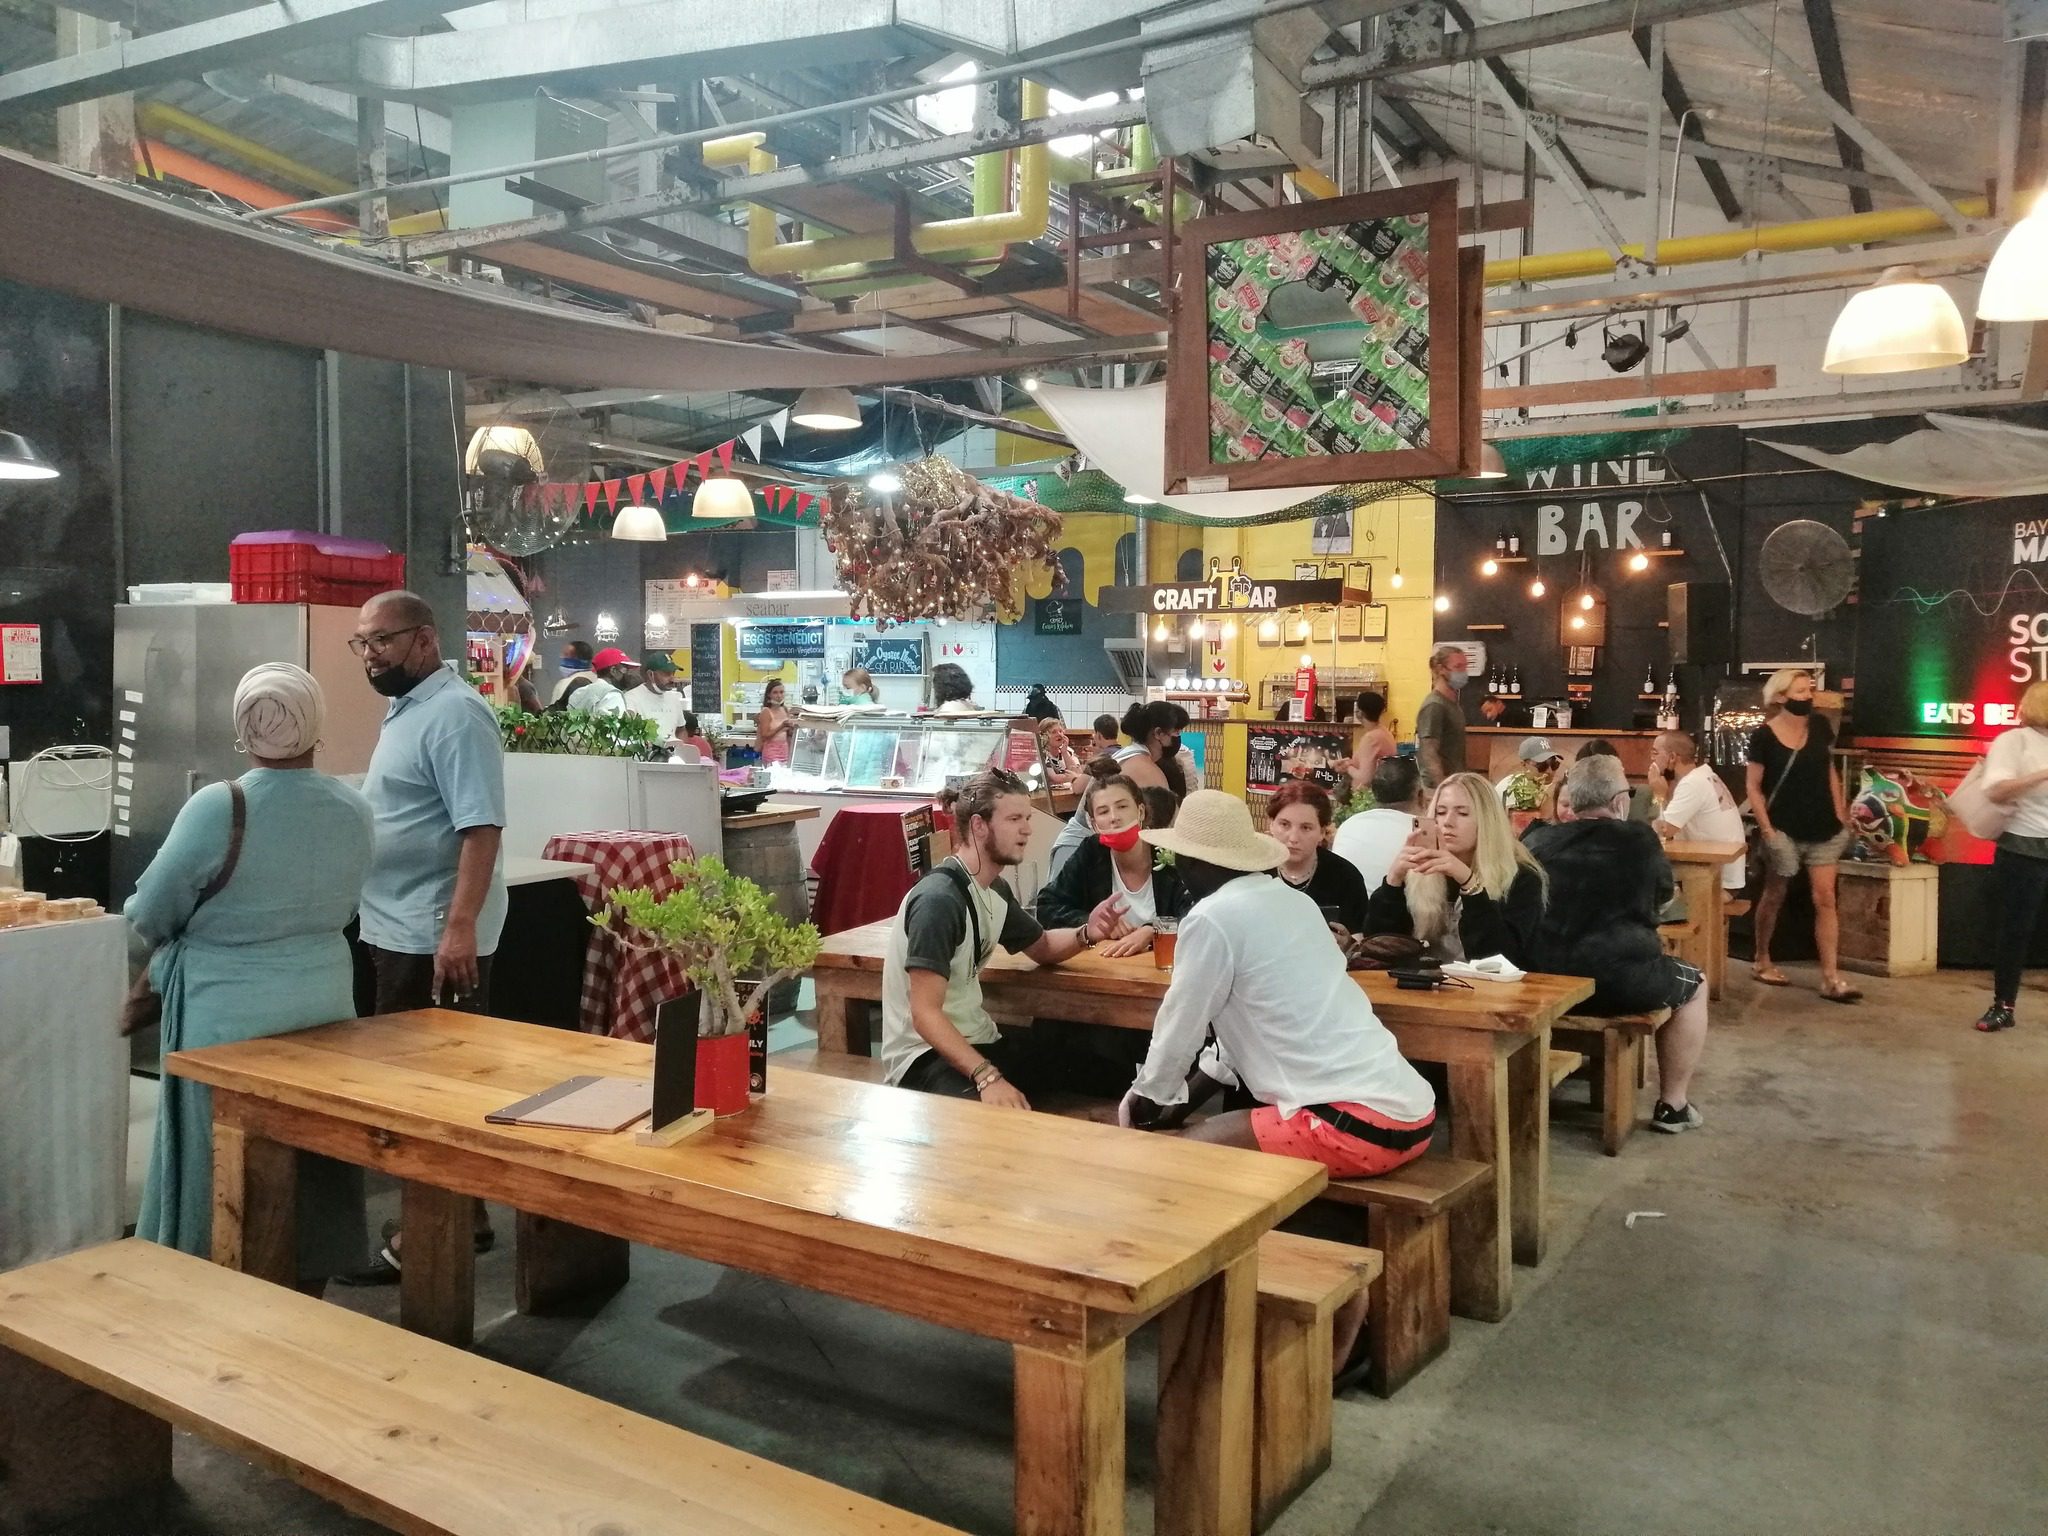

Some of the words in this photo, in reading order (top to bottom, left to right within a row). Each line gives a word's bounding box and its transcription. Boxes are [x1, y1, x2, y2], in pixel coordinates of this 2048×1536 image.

[1537, 502, 1645, 555] BAR
[746, 600, 789, 617] seabar
[1153, 587, 1217, 611] CRAFT
[743, 632, 771, 646] EGGS
[775, 631, 823, 645] BENEDICT
[874, 662, 889, 674] SEA
[889, 662, 905, 673] BAR
[1923, 702, 1976, 725] EATS
